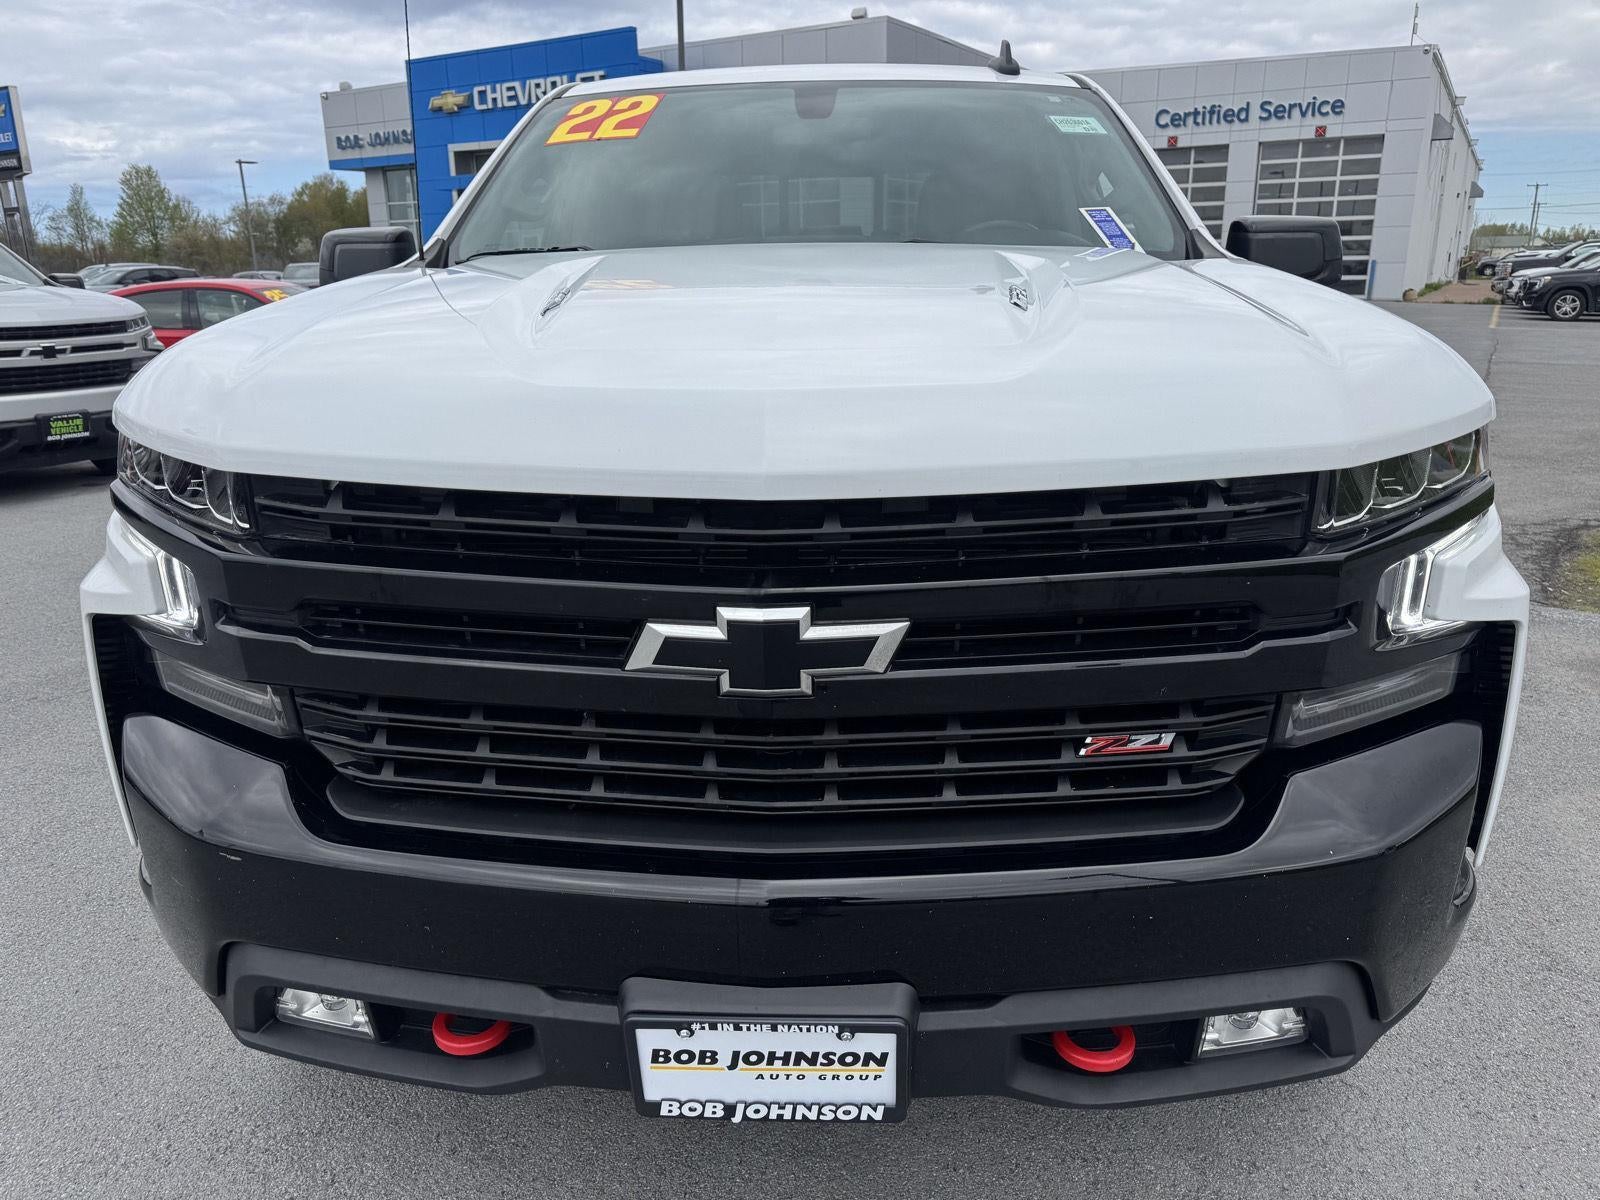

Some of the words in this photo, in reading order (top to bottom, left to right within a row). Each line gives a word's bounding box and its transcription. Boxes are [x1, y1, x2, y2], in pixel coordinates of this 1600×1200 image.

[546, 94, 660, 145] 22
[1155, 101, 1250, 129] Certified
[1258, 96, 1345, 122] Service
[50, 419, 83, 428] VALUE
[50, 425, 84, 434] VEHICLE
[61, 431, 90, 440] JOHNSON
[1078, 732, 1176, 757] Z71
[690, 1021, 710, 1032] #1
[717, 1022, 735, 1032] IN
[739, 1023, 772, 1033] THE
[777, 1024, 839, 1034] NATION
[650, 1048, 719, 1066] BOB
[726, 1050, 889, 1071] JOHNSON
[754, 1073, 807, 1081] AUTO
[818, 1073, 883, 1081] GROUP
[659, 1100, 725, 1118] BOB
[732, 1102, 885, 1124] JOHNSON
